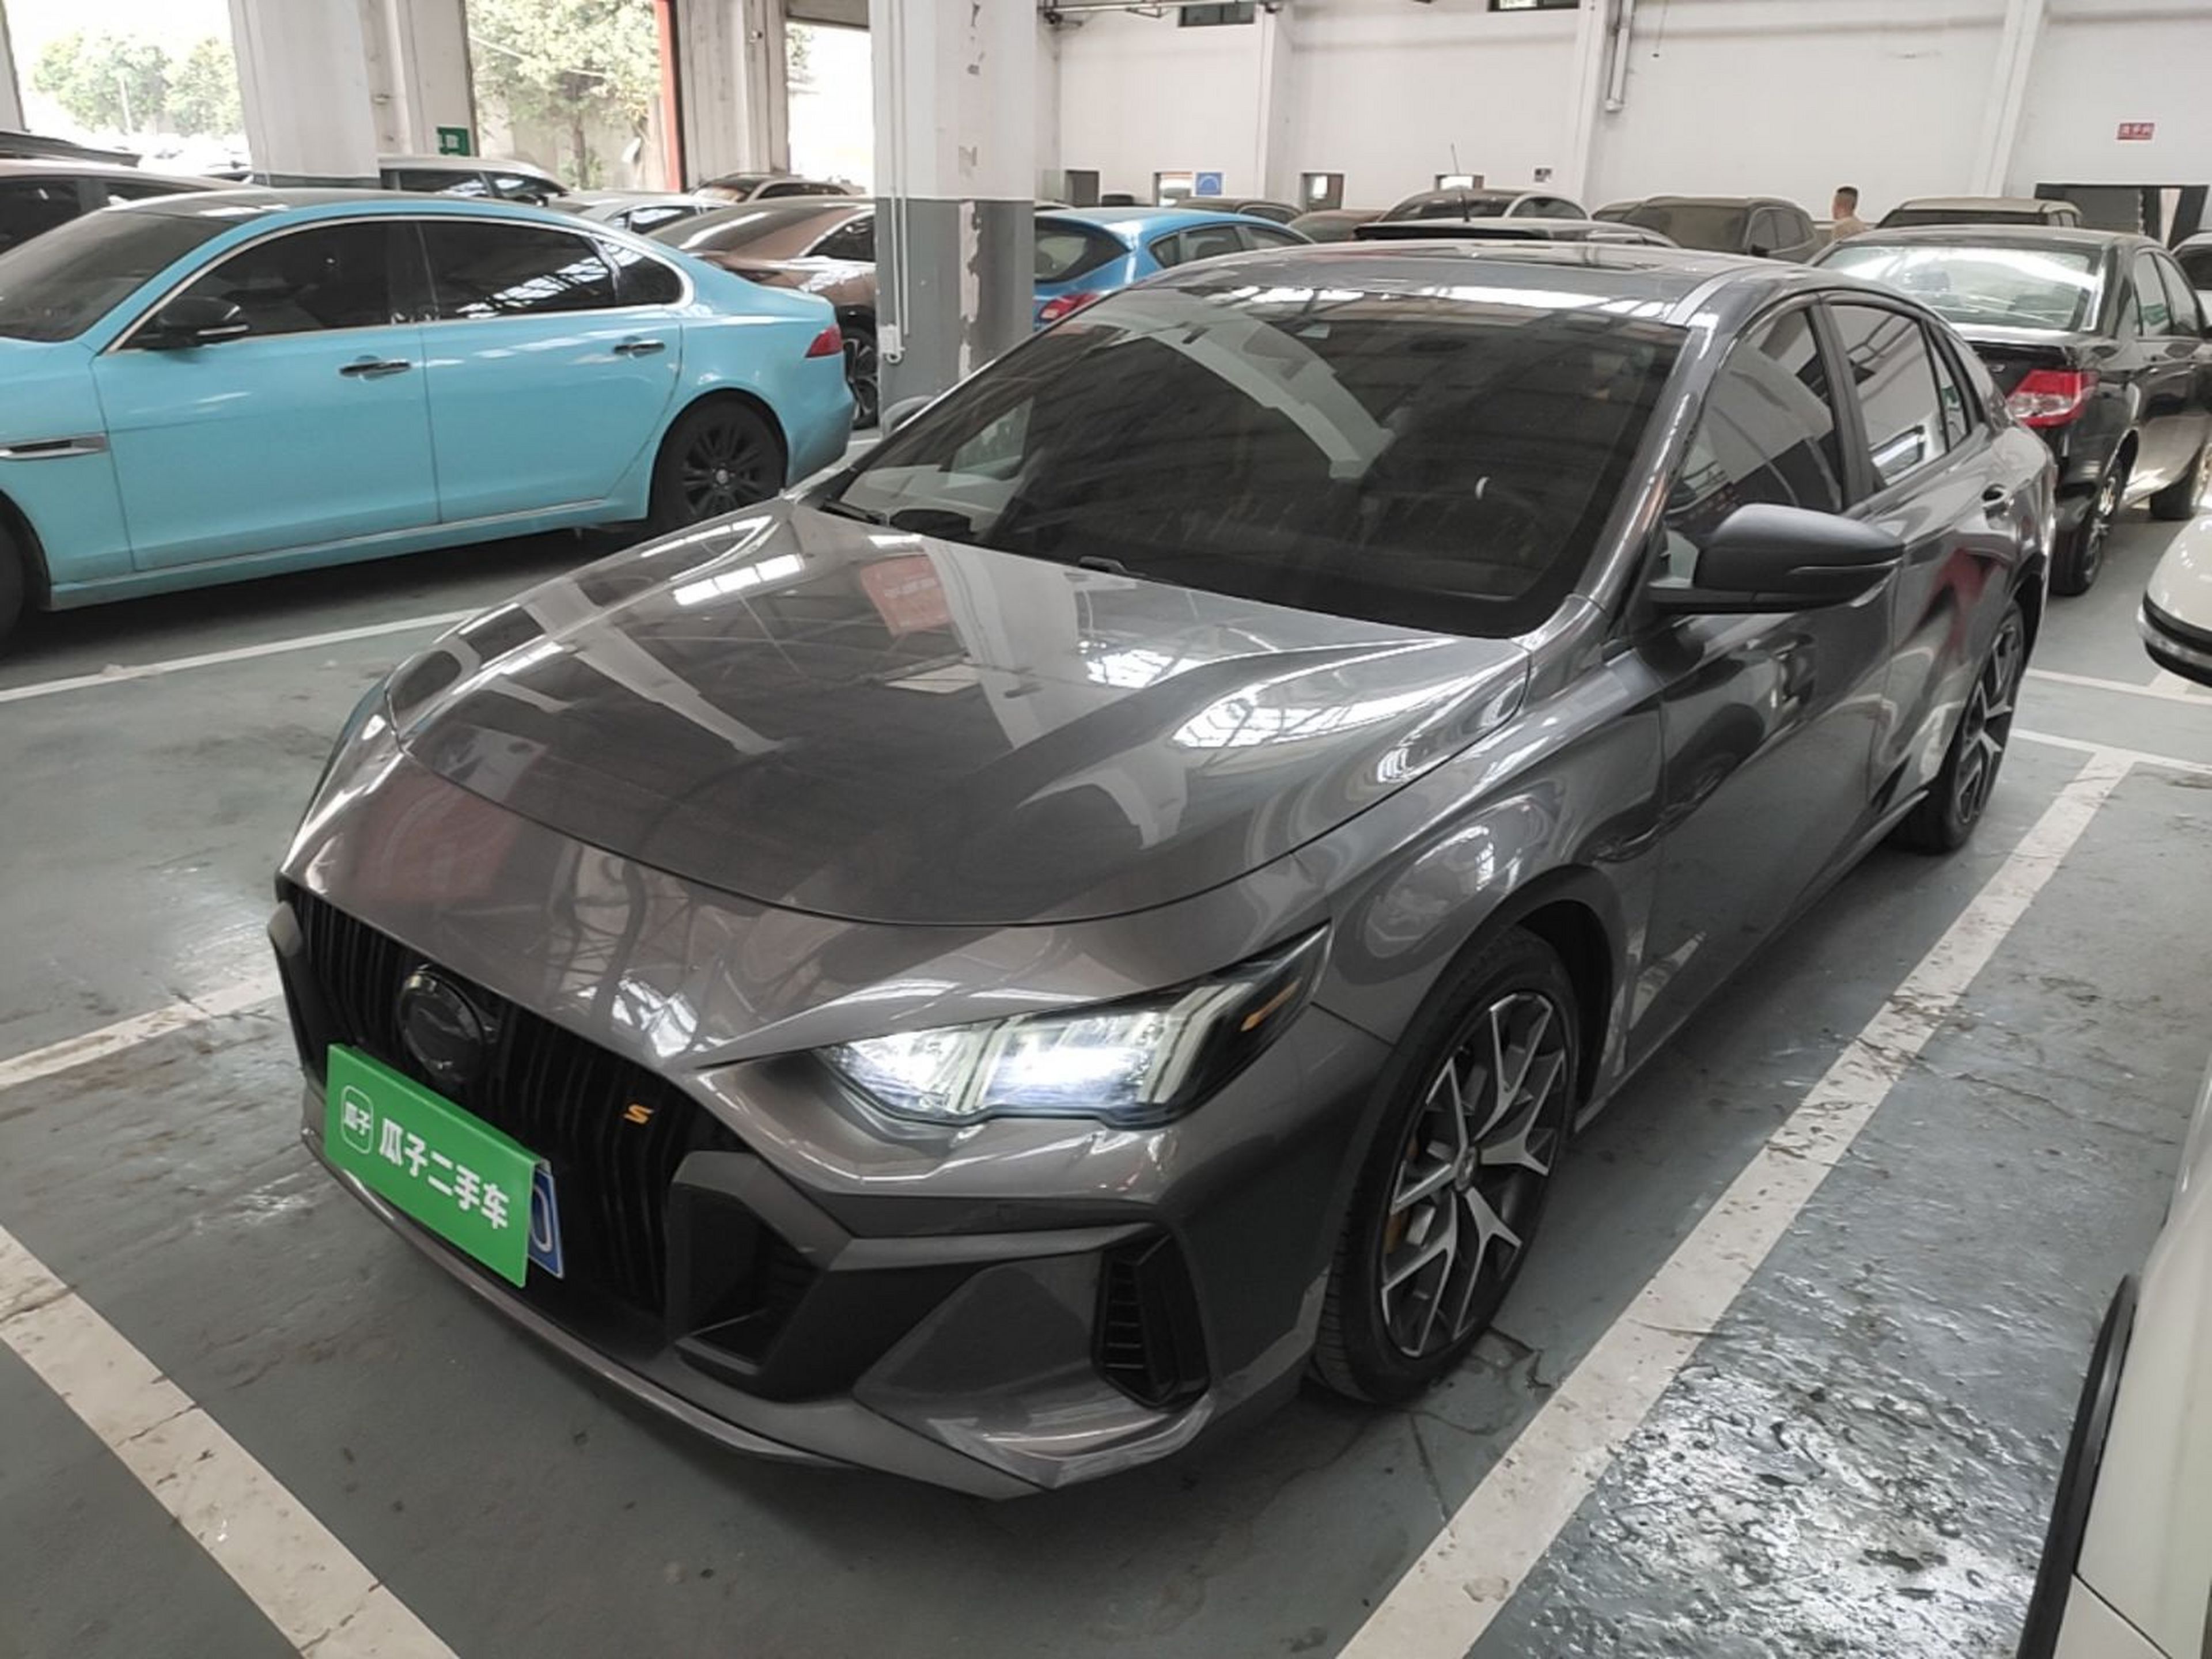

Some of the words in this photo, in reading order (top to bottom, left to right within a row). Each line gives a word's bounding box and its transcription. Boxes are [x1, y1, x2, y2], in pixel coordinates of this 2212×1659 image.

[623, 1104, 654, 1124] S
[379, 1118, 509, 1229] 瓜子二手车
